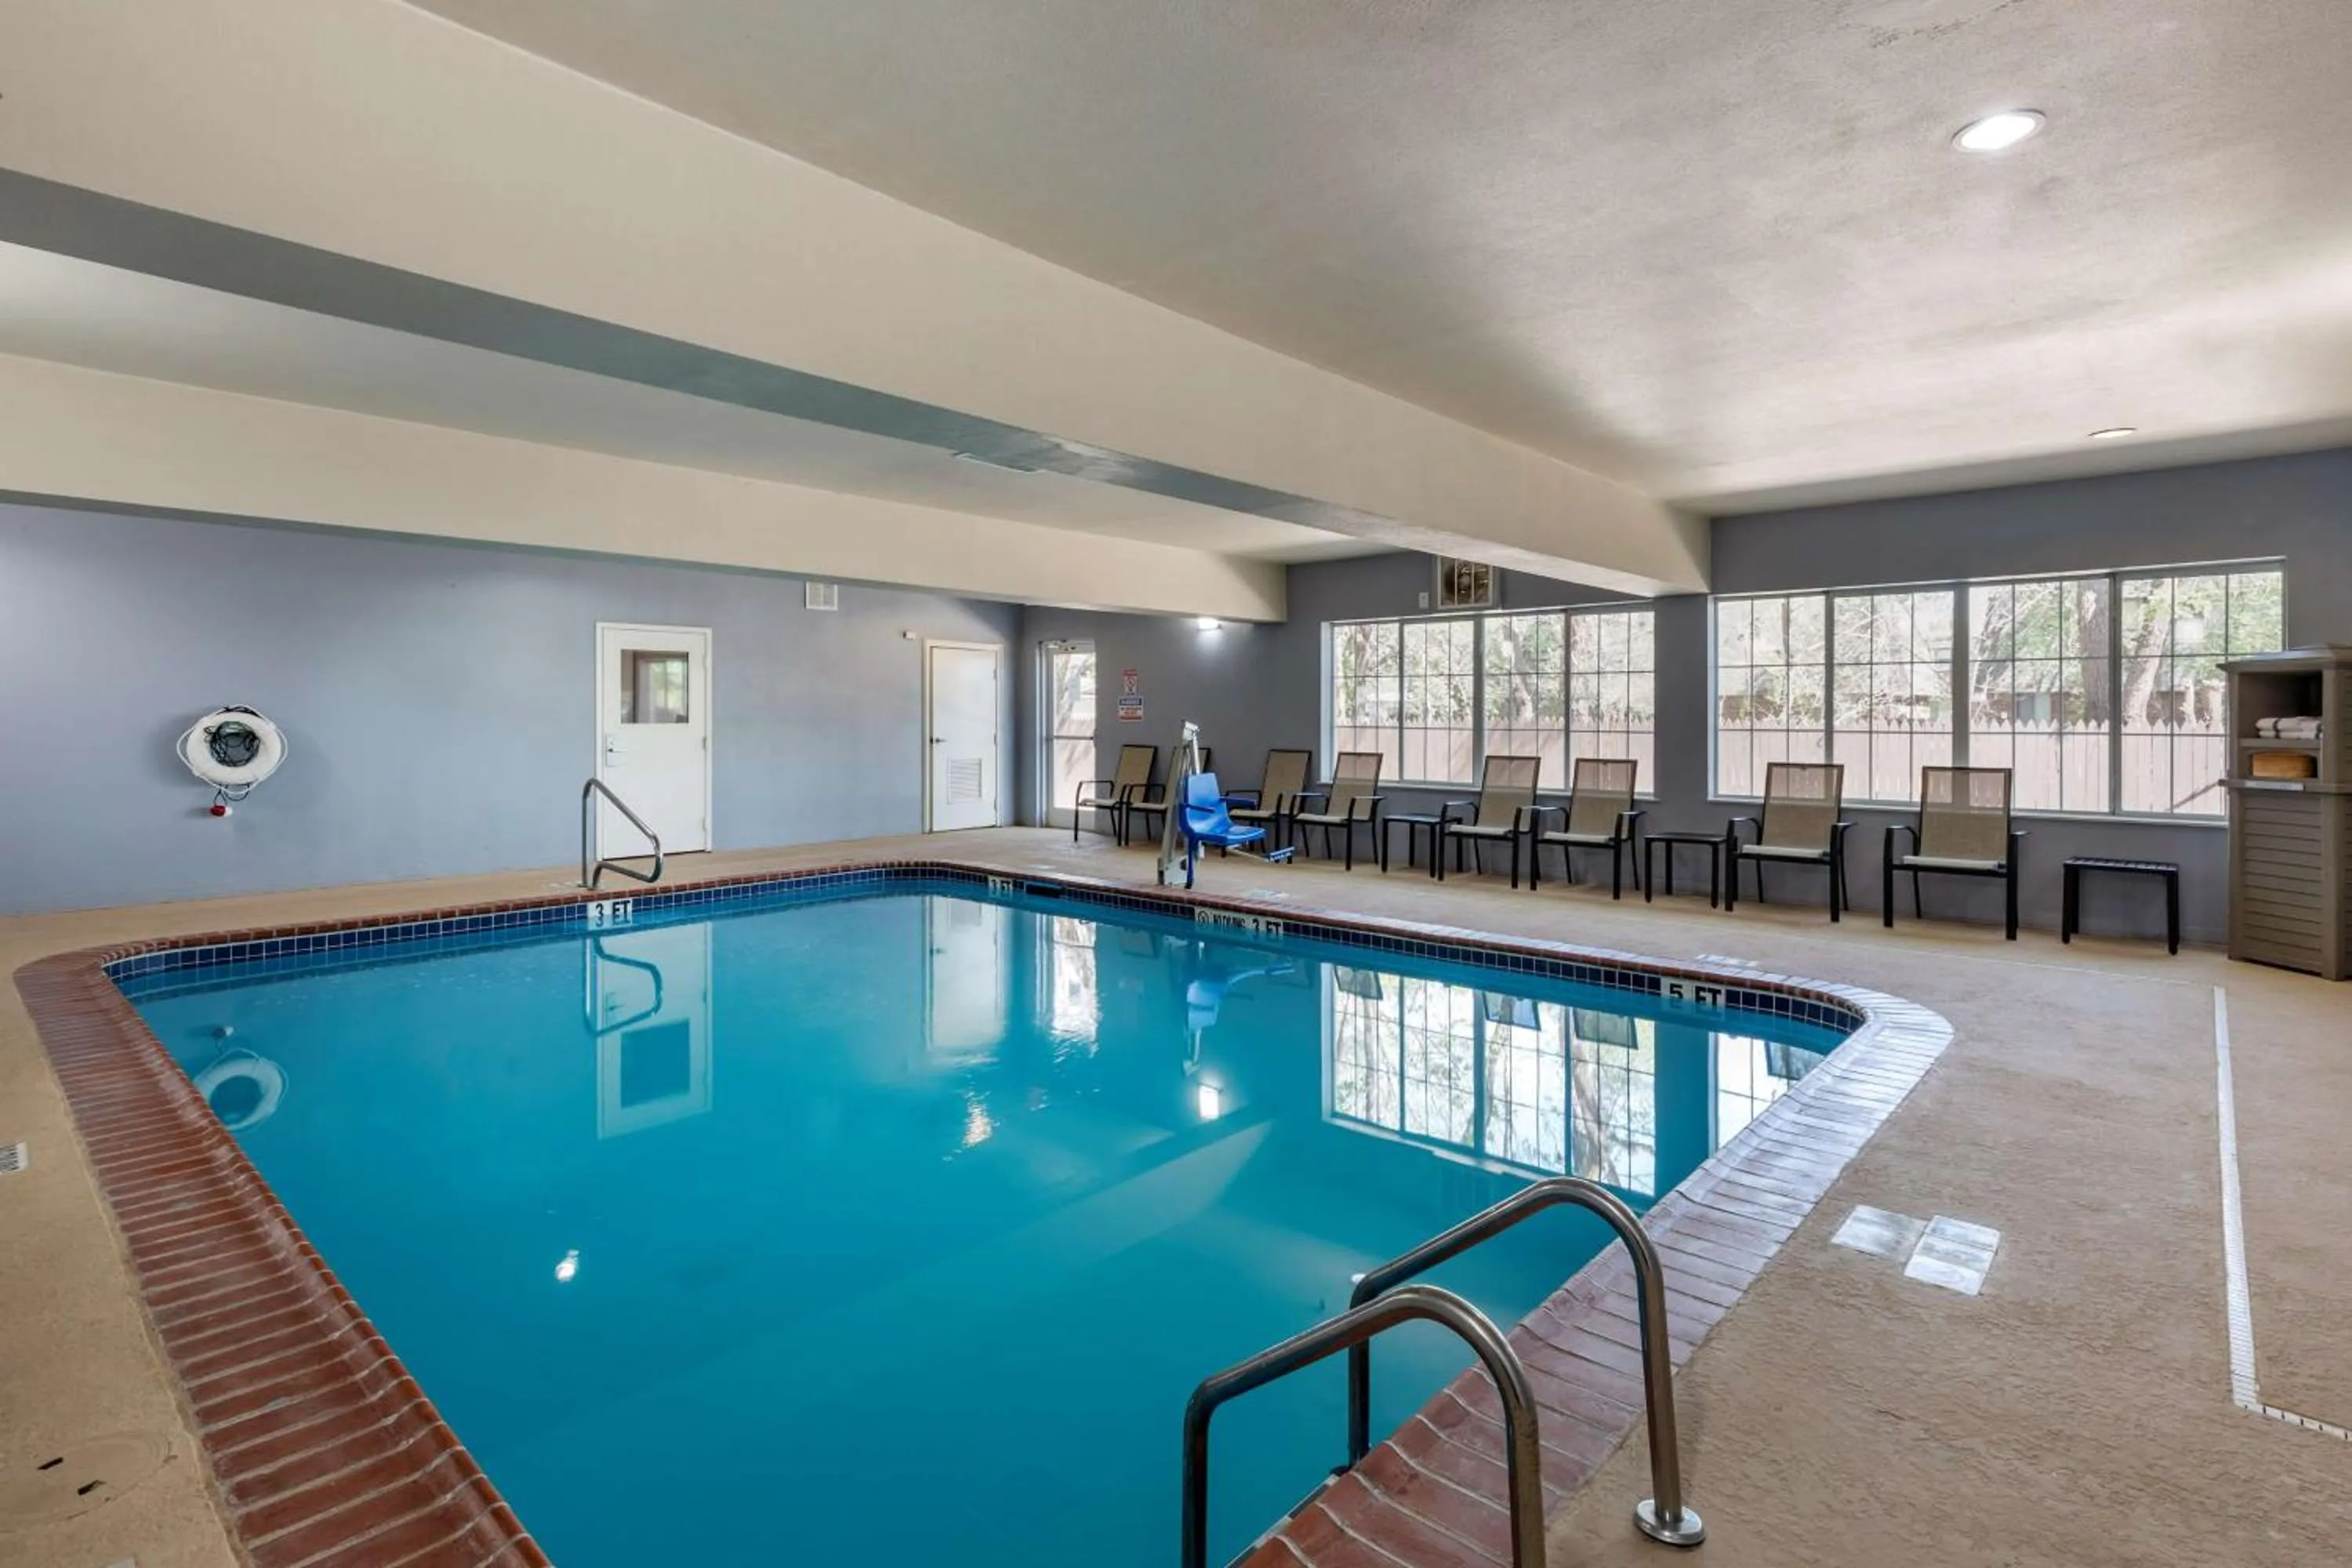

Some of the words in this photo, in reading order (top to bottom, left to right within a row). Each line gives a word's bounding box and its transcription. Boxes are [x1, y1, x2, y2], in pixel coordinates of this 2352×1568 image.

[595, 902, 604, 916] 3
[612, 900, 630, 916] FT
[1669, 983, 1683, 1000] 5
[1695, 985, 1722, 1006] FT
